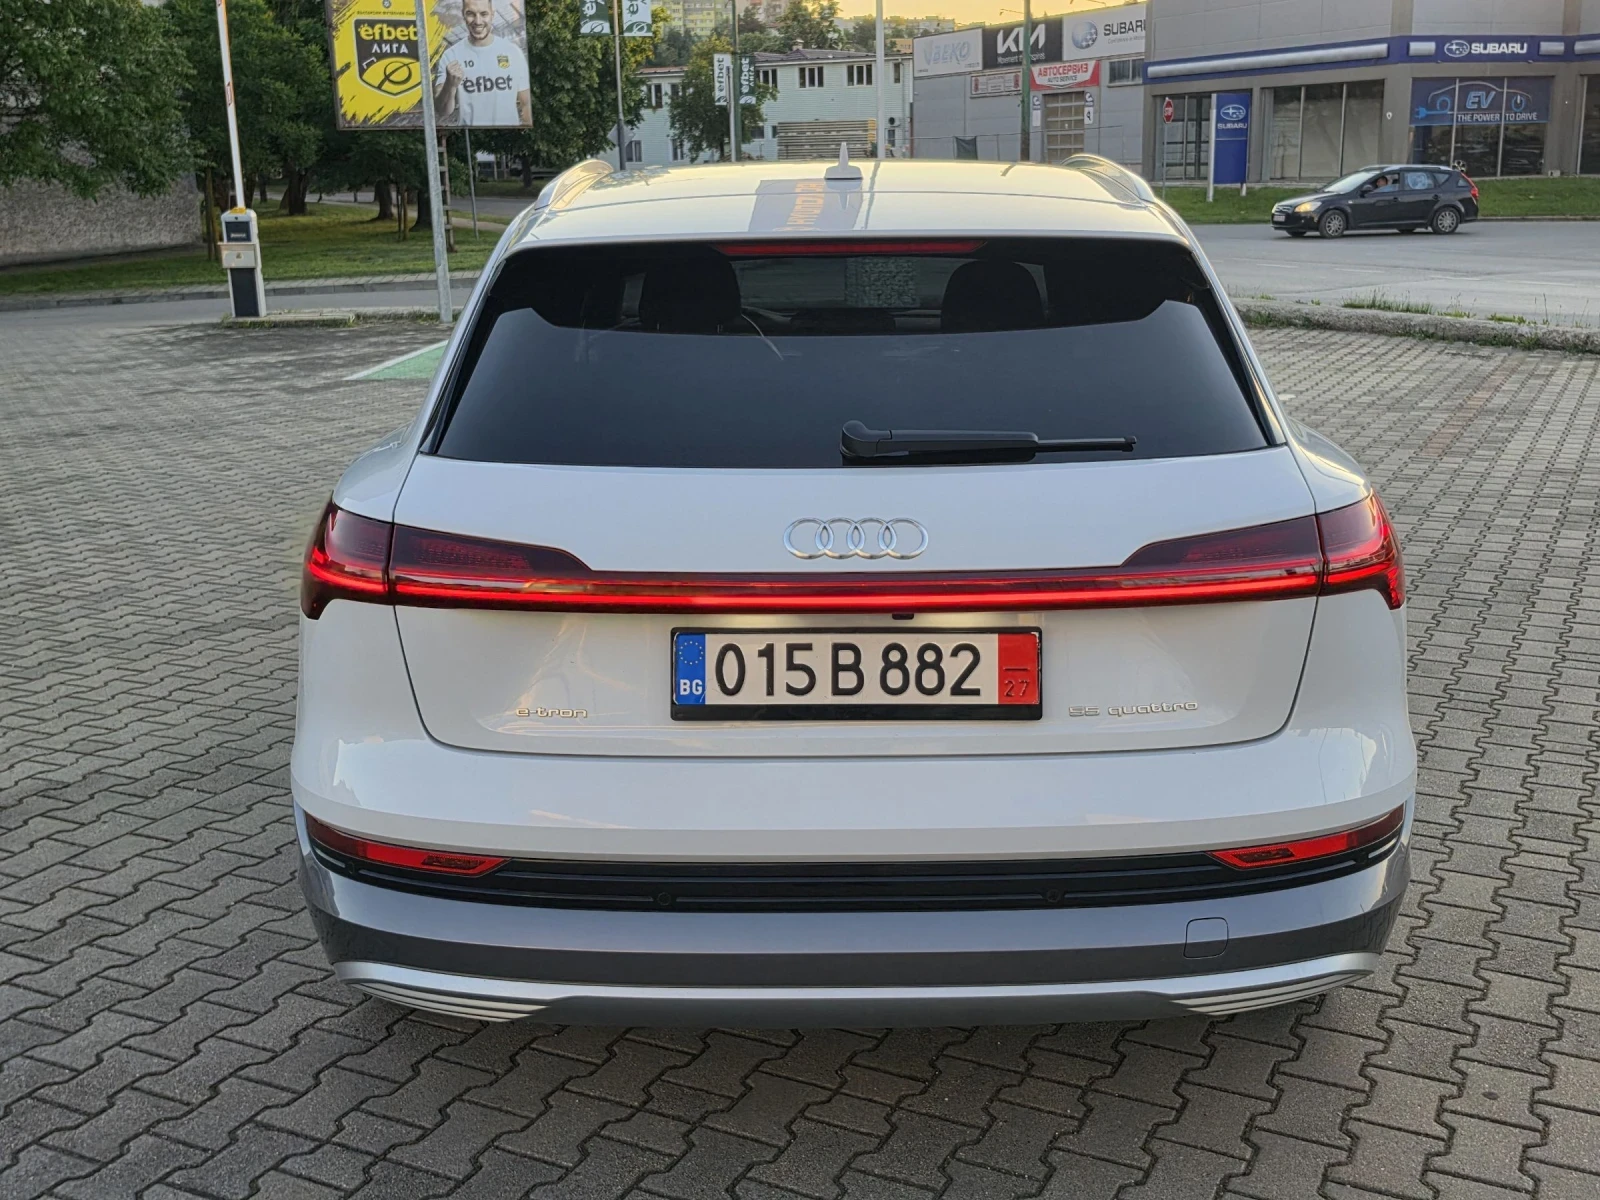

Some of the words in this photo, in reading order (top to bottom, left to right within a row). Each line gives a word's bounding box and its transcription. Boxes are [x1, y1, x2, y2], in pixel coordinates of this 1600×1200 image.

[358, 23, 418, 40] efbet
[372, 43, 408, 53] ЛИГА
[1471, 43, 1528, 54] SUBARU
[464, 60, 475, 68] 10
[1038, 63, 1088, 77] АВТОСЕРВИЗ
[740, 57, 749, 93] efbet
[461, 75, 512, 93] efbet
[1466, 91, 1496, 109] EV
[1473, 113, 1500, 121] POWER
[1516, 112, 1537, 120] DRIVE
[680, 679, 703, 695] BG
[1004, 680, 1029, 697] 27
[516, 707, 588, 718] e-tron
[1108, 702, 1198, 717] quattro
